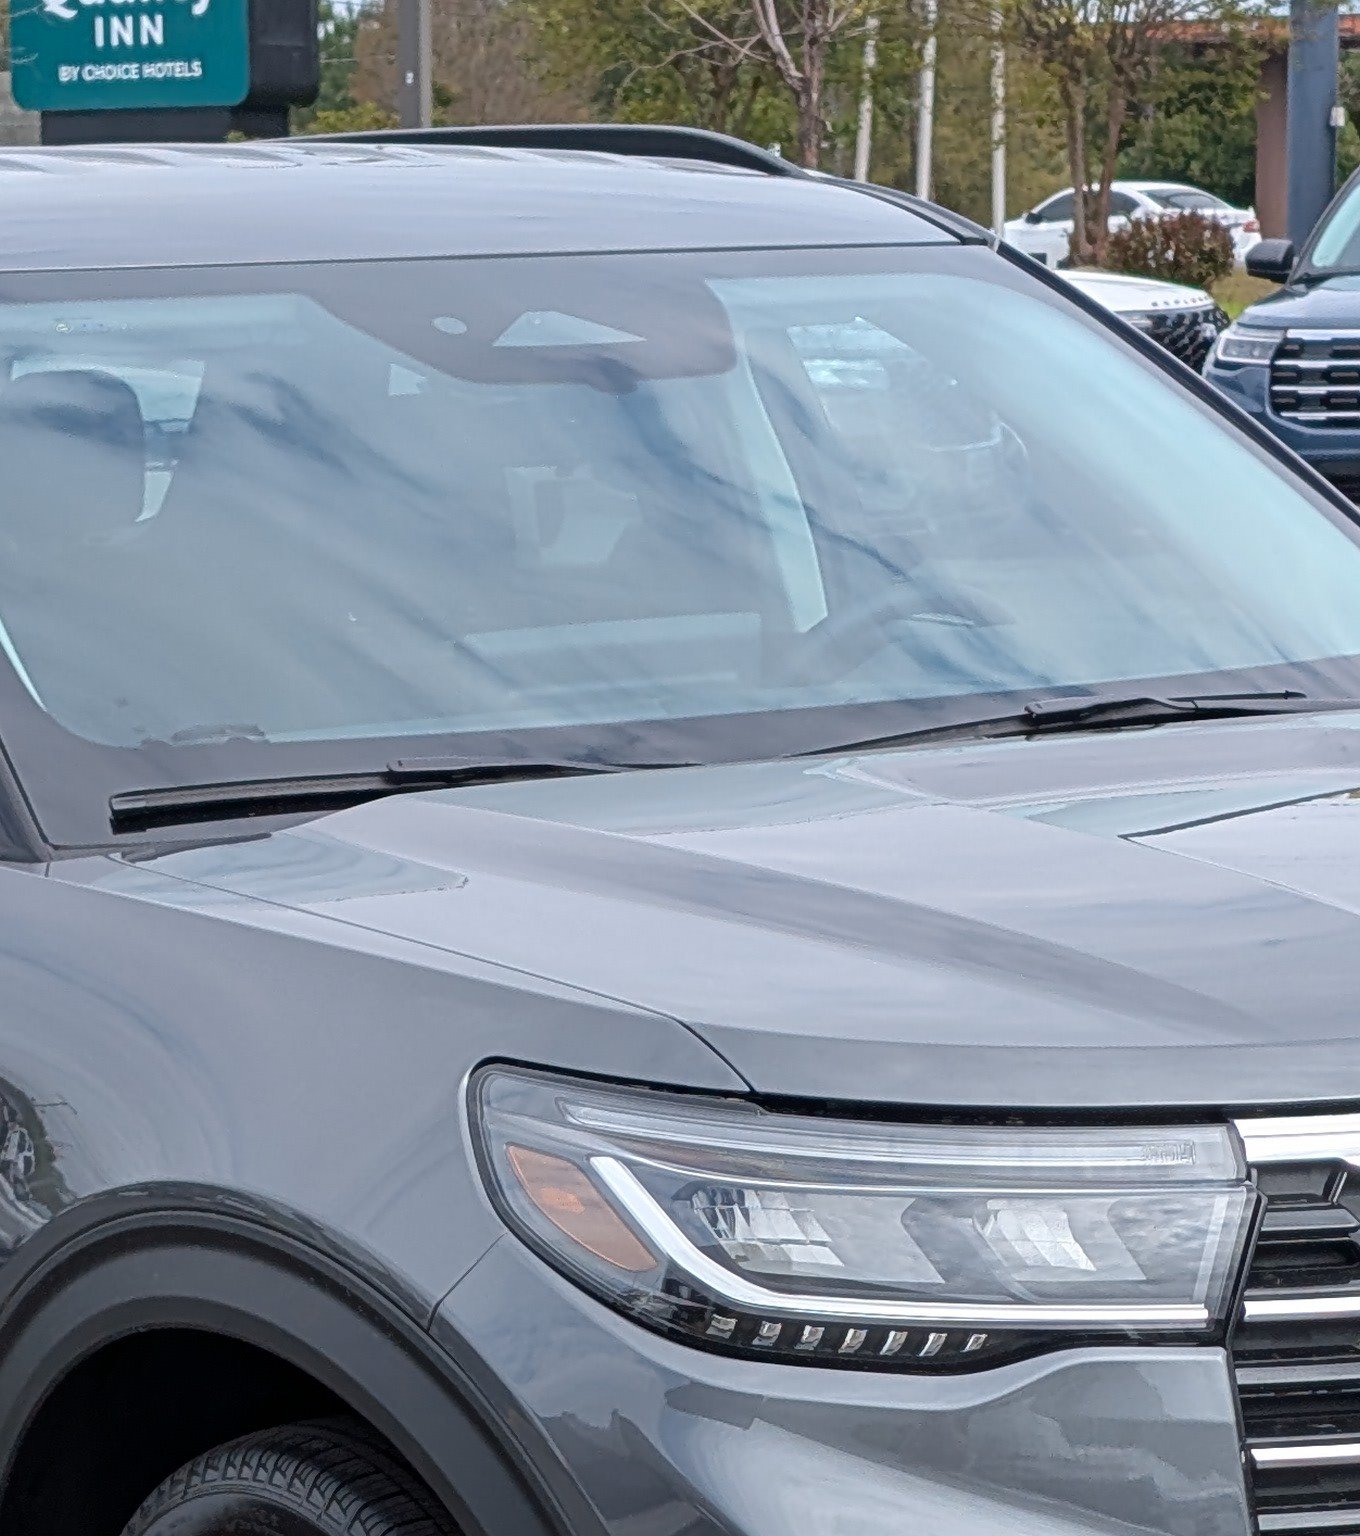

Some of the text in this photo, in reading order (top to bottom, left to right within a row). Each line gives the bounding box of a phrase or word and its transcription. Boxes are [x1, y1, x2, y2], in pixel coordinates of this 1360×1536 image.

[93, 14, 164, 48] INN
[58, 60, 202, 82] BY CHOICE HOTELS
